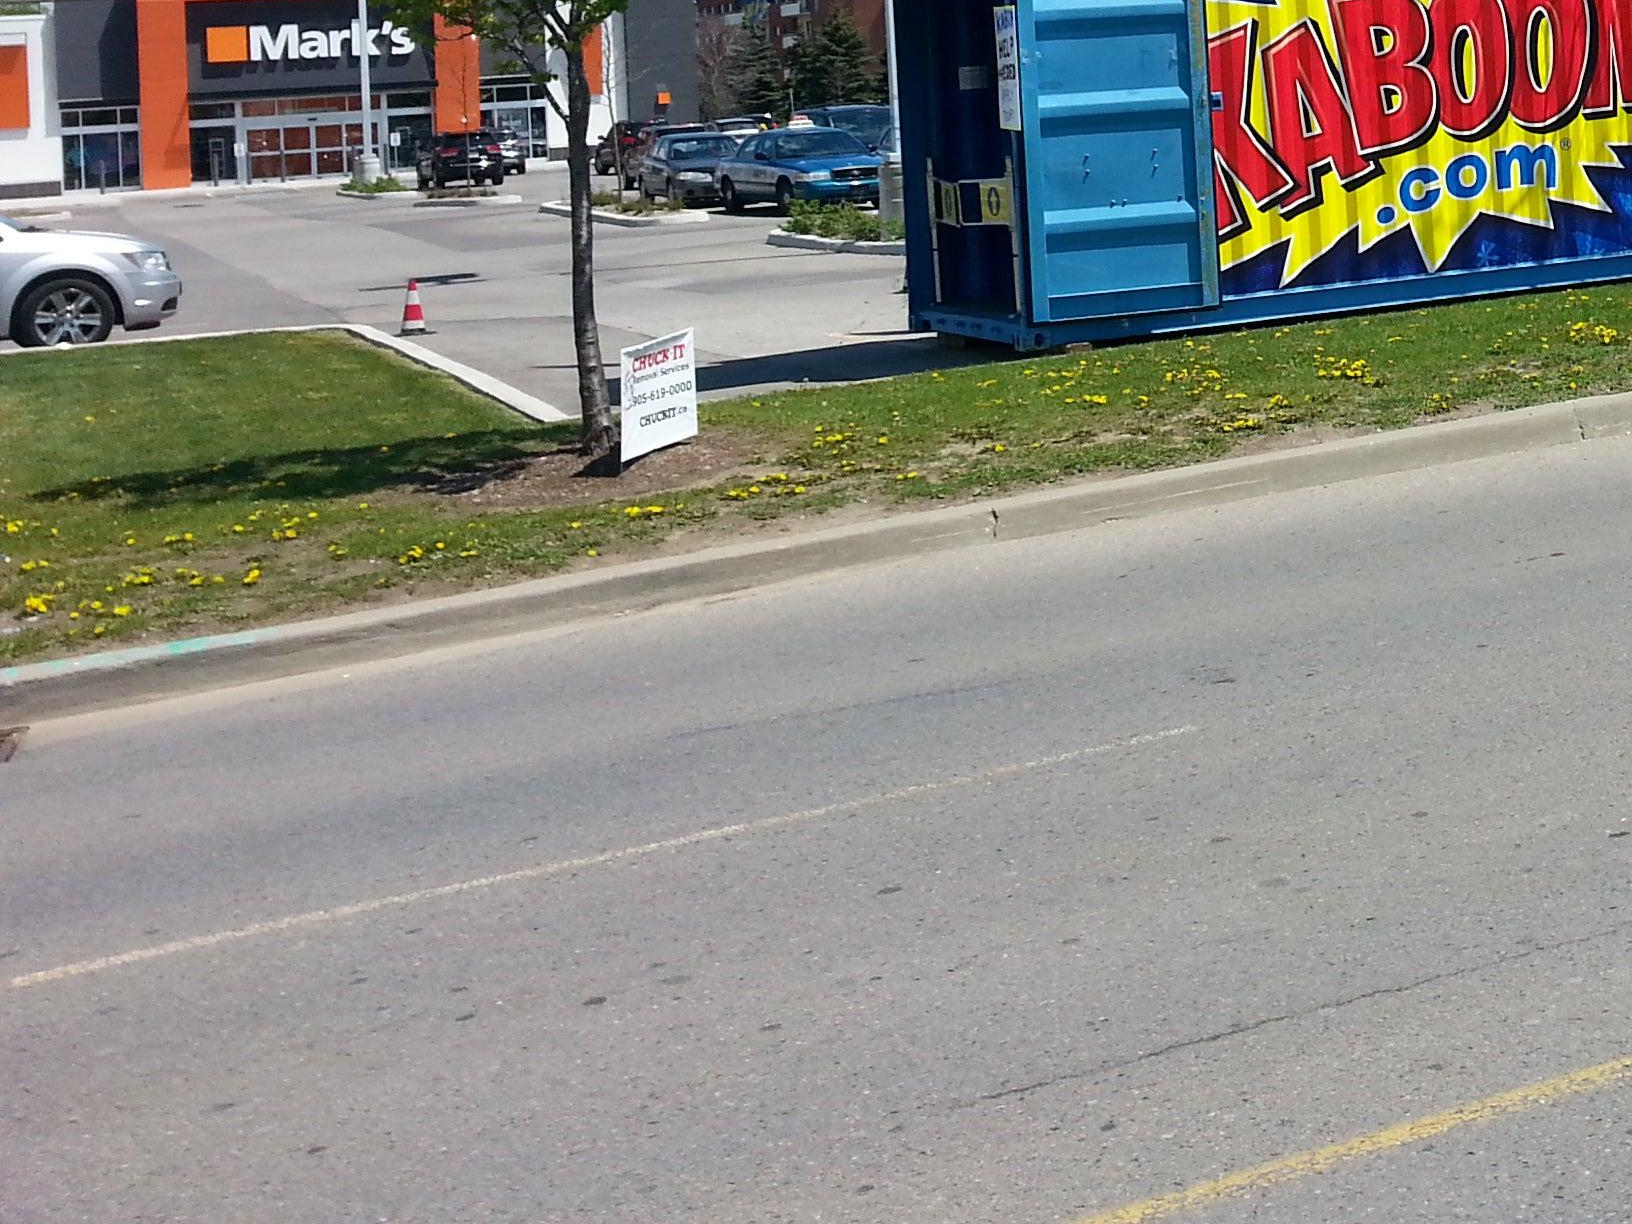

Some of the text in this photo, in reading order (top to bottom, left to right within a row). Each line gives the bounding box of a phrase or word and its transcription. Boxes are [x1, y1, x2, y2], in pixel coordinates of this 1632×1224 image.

[249, 19, 415, 62] Mark's
[1376, 143, 1557, 225] .com
[632, 381, 692, 406] 905-619-0000
